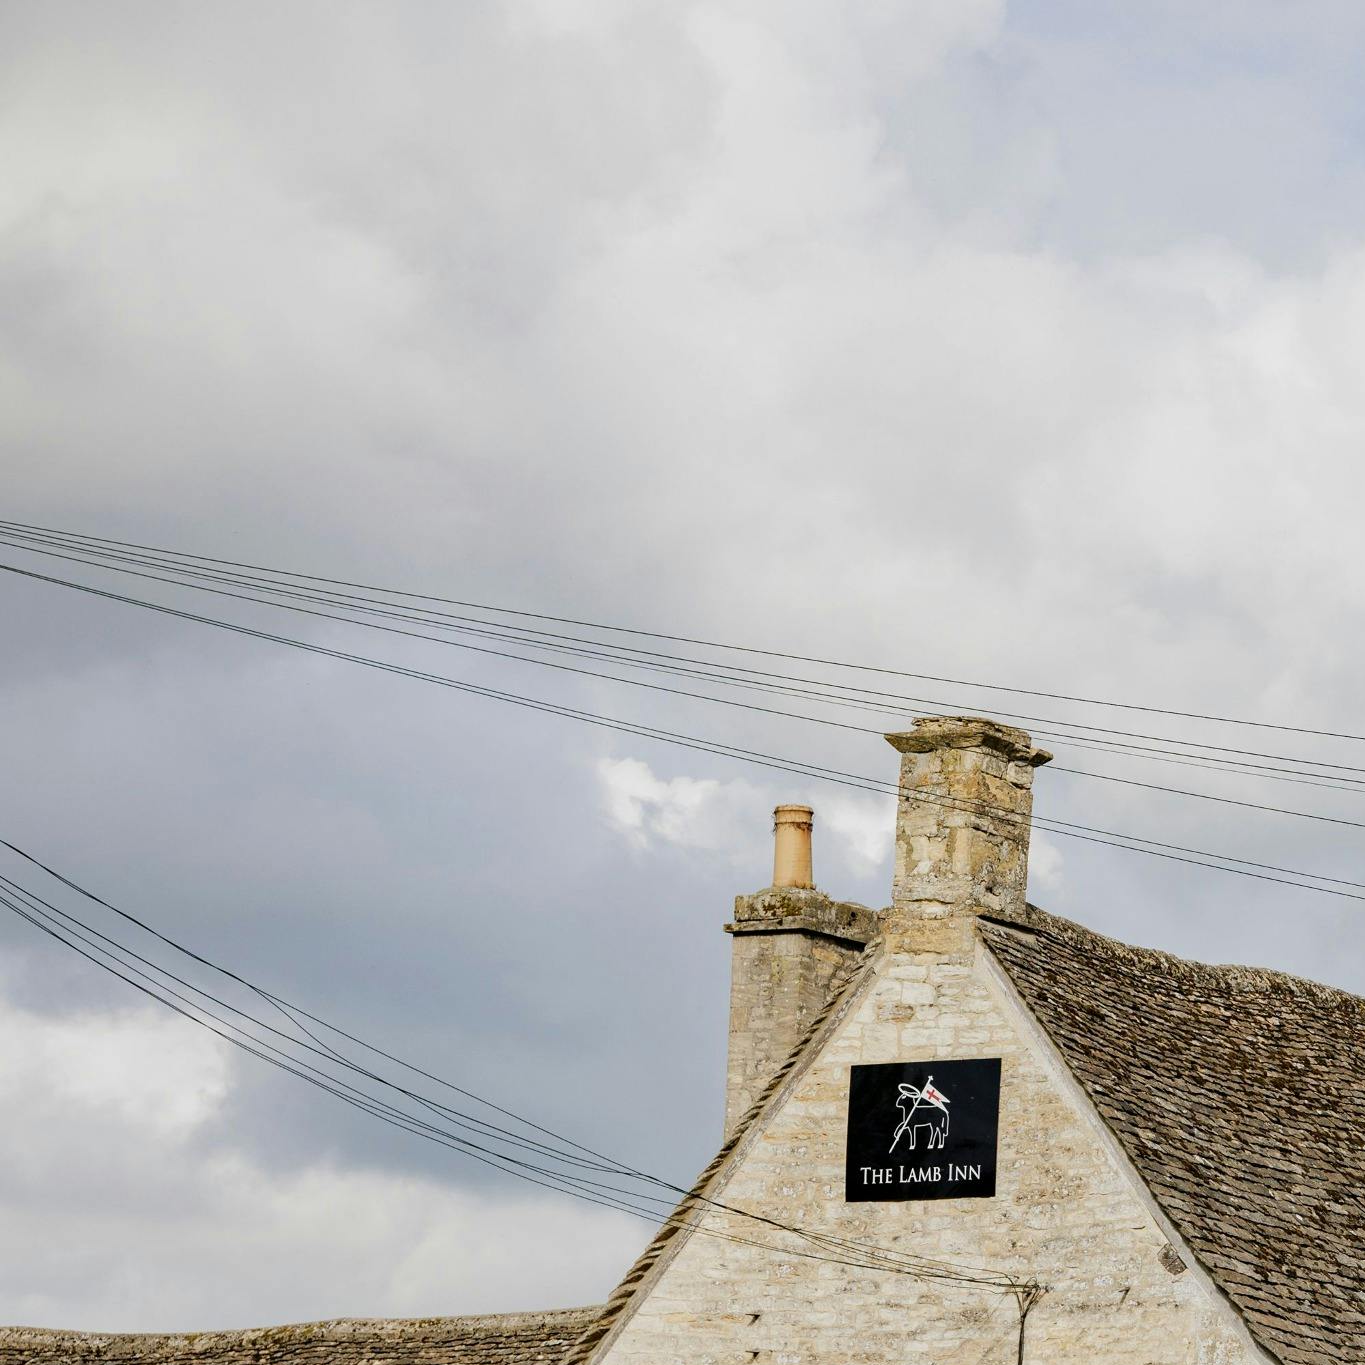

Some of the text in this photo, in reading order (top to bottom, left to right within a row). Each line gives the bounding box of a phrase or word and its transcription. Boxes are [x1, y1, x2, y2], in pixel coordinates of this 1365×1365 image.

[860, 1163, 982, 1185] THE LAMB INN
